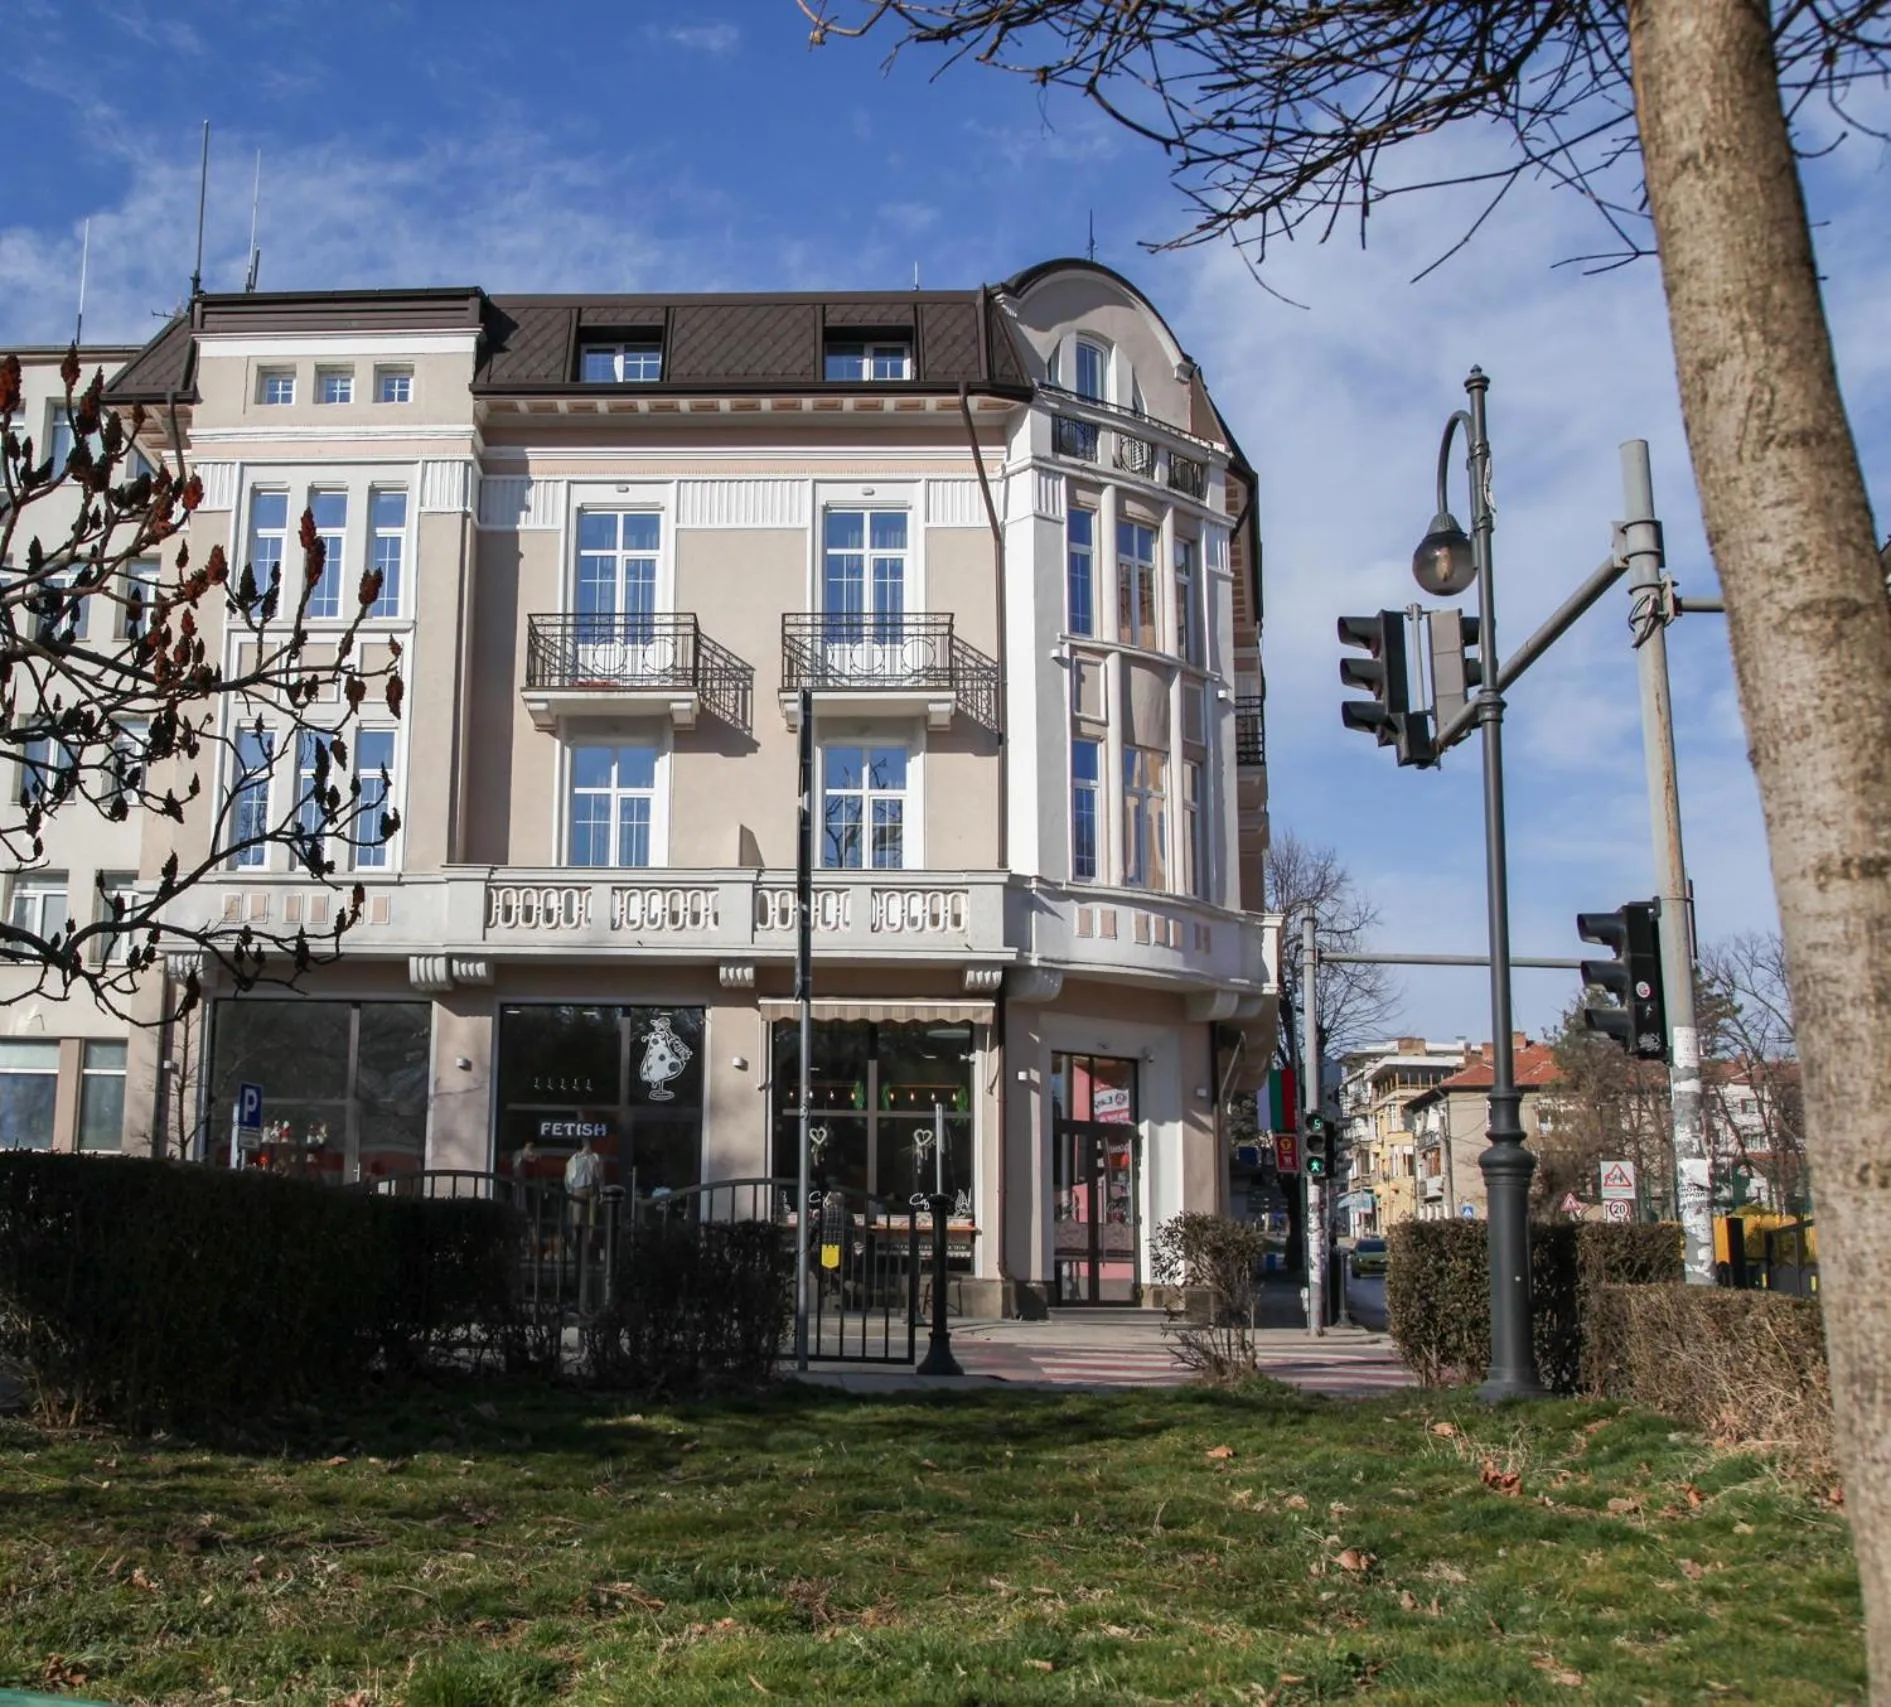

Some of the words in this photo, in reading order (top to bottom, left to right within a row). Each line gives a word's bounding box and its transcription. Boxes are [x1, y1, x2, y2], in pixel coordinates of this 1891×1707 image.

[243, 1088, 258, 1122] P
[540, 1122, 607, 1137] FETISH
[1613, 1204, 1626, 1214] 20
